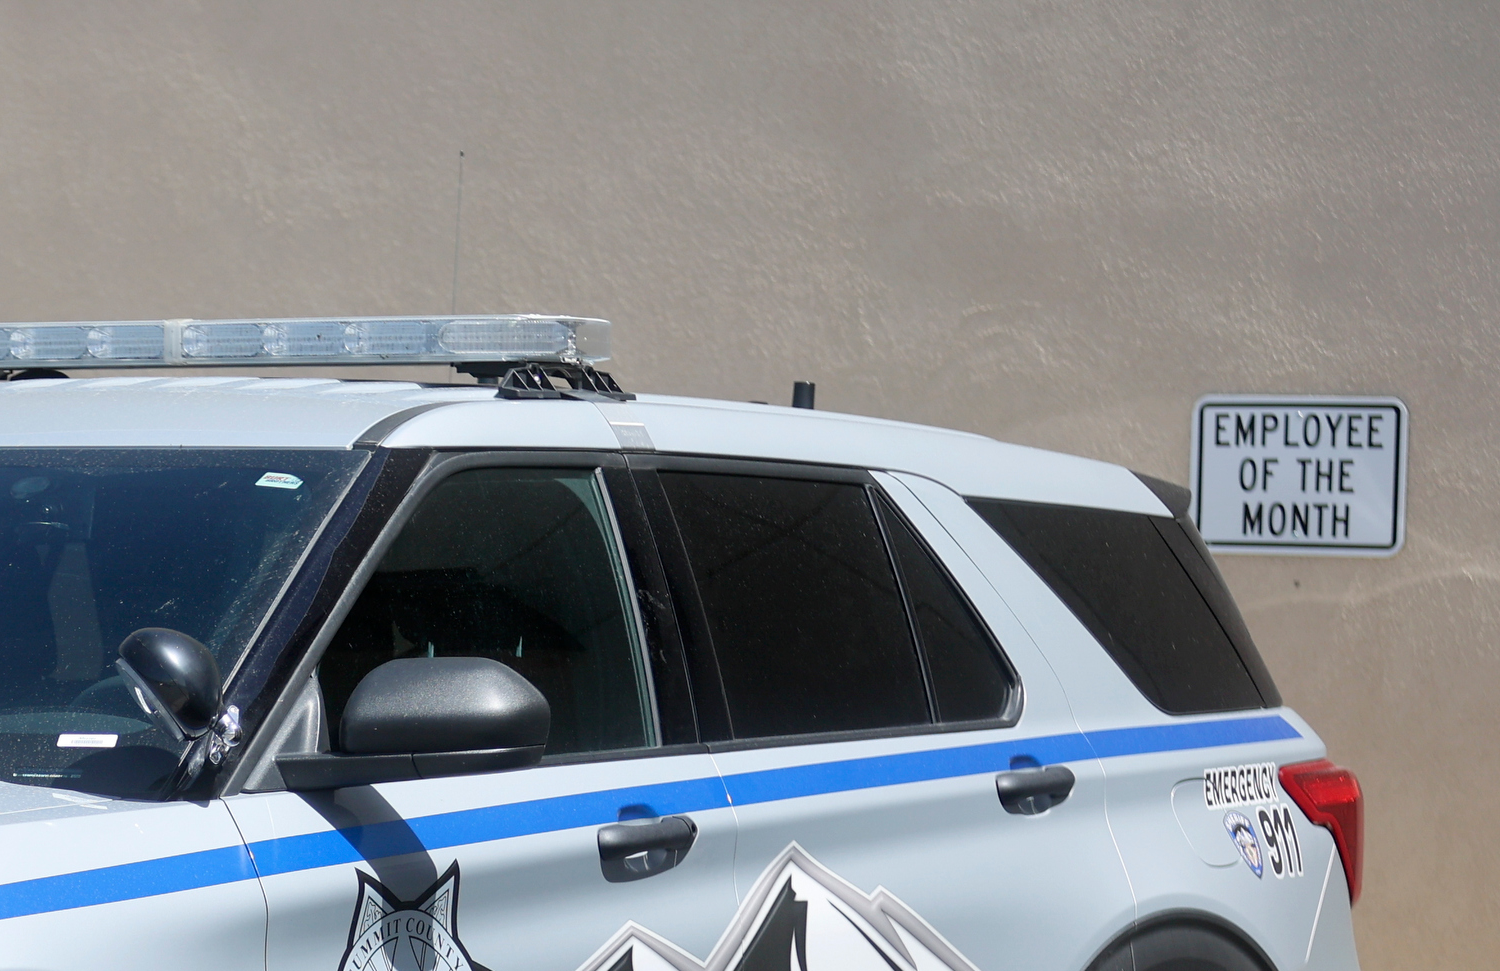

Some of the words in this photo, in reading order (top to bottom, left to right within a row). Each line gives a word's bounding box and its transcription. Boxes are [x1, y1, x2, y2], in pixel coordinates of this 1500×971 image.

[1214, 412, 1384, 448] EMPLOYEE
[1238, 457, 1279, 492] OF
[1297, 458, 1354, 493] THE
[1242, 502, 1350, 538] MONTH
[1205, 765, 1277, 806] EMERGENCY
[1258, 807, 1302, 875] 911
[405, 918, 464, 971] COUNTY
